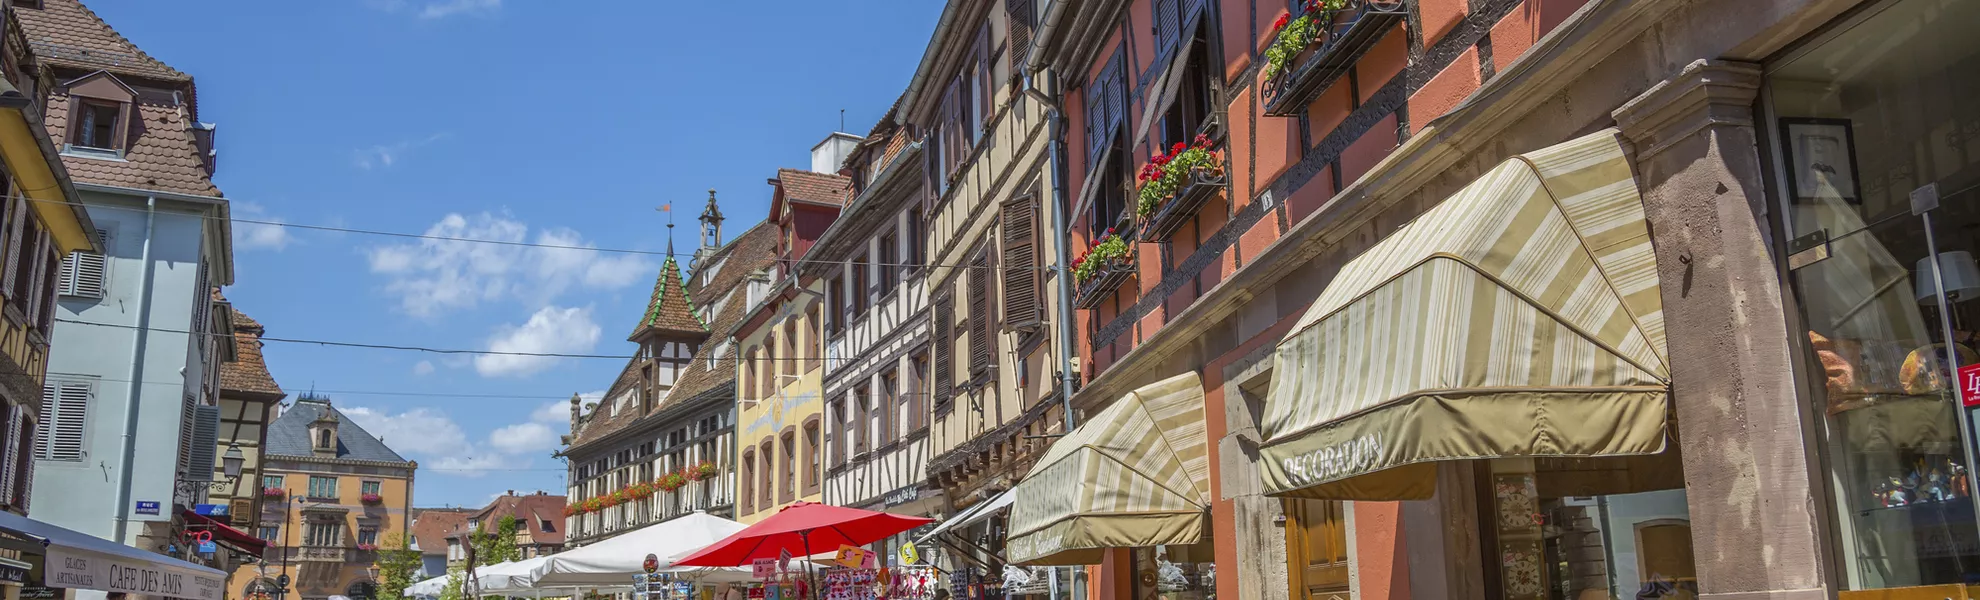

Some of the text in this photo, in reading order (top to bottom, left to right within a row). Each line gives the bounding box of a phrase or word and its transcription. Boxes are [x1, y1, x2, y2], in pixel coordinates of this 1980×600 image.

[65, 556, 87, 571] GLACES
[56, 571, 94, 586] ARTISANALES
[109, 563, 138, 591] CAFE
[140, 568, 159, 593] DES
[161, 571, 183, 595] AMIS
